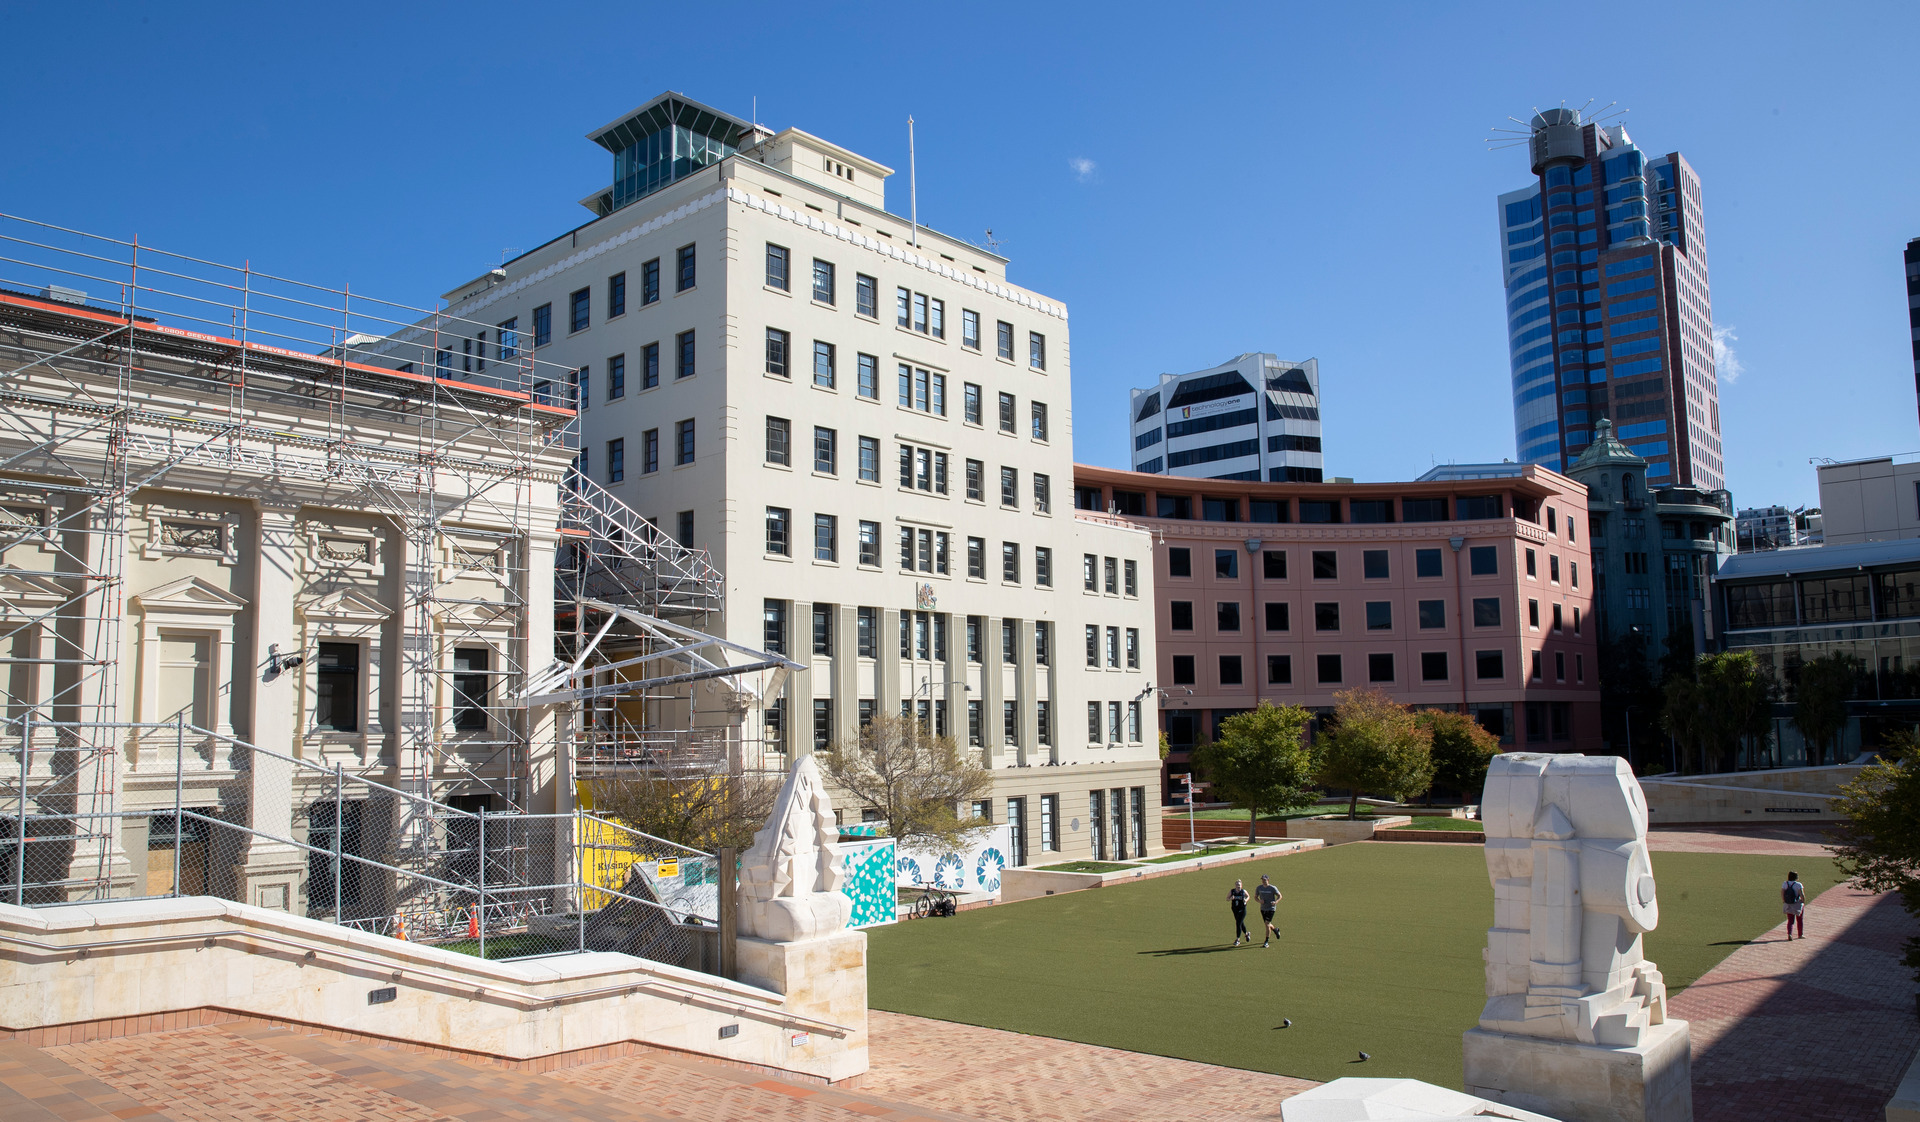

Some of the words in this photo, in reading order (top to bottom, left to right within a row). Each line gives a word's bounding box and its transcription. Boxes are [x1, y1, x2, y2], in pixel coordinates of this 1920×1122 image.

[164, 327, 185, 336] 0800
[187, 332, 217, 342] GEEVES
[259, 344, 287, 355] GEEVES
[288, 351, 335, 364] SCAFFOLDING
[598, 861, 629, 871] Kising
